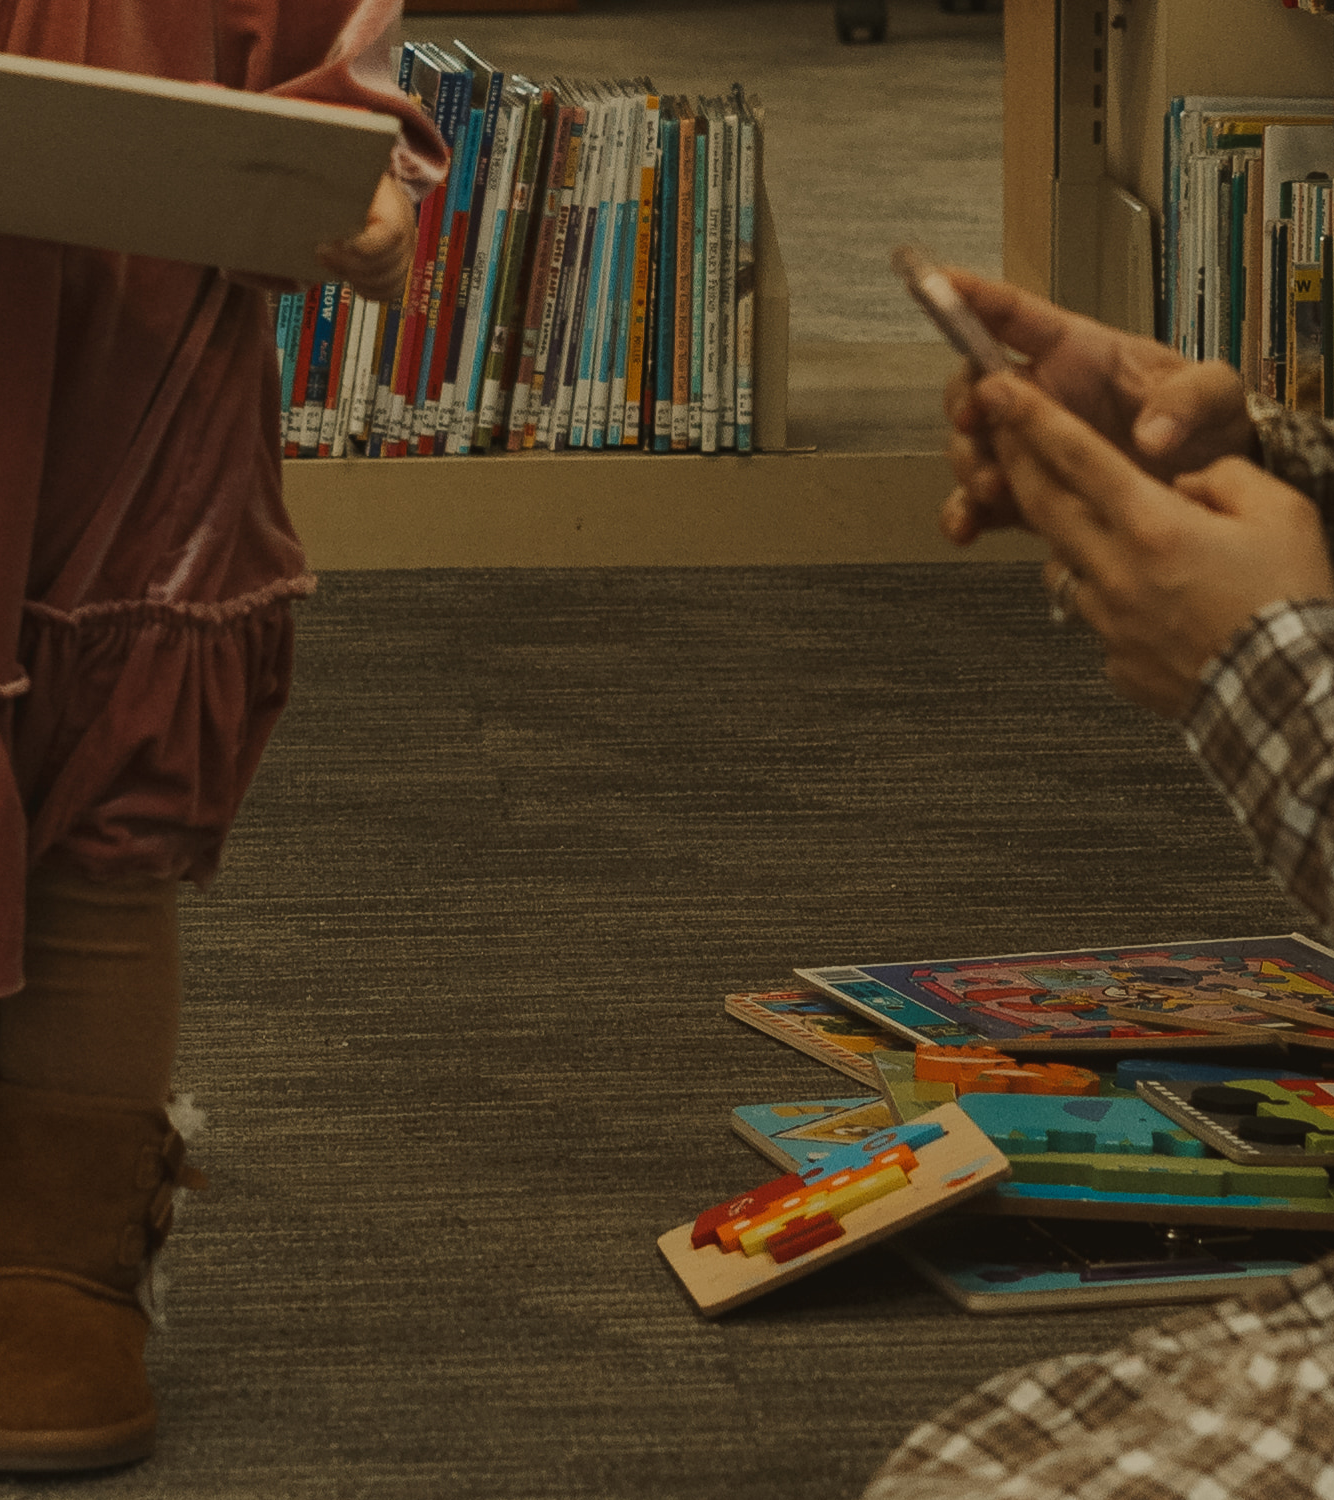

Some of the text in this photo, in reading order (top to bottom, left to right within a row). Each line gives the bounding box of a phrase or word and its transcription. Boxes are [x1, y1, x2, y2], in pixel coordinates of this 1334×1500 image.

[429, 236, 450, 329] SEE ME RUN
[460, 274, 470, 295] WANT
[632, 233, 650, 364] BUSY STREET MILLER
[707, 279, 717, 313] FRIEND
